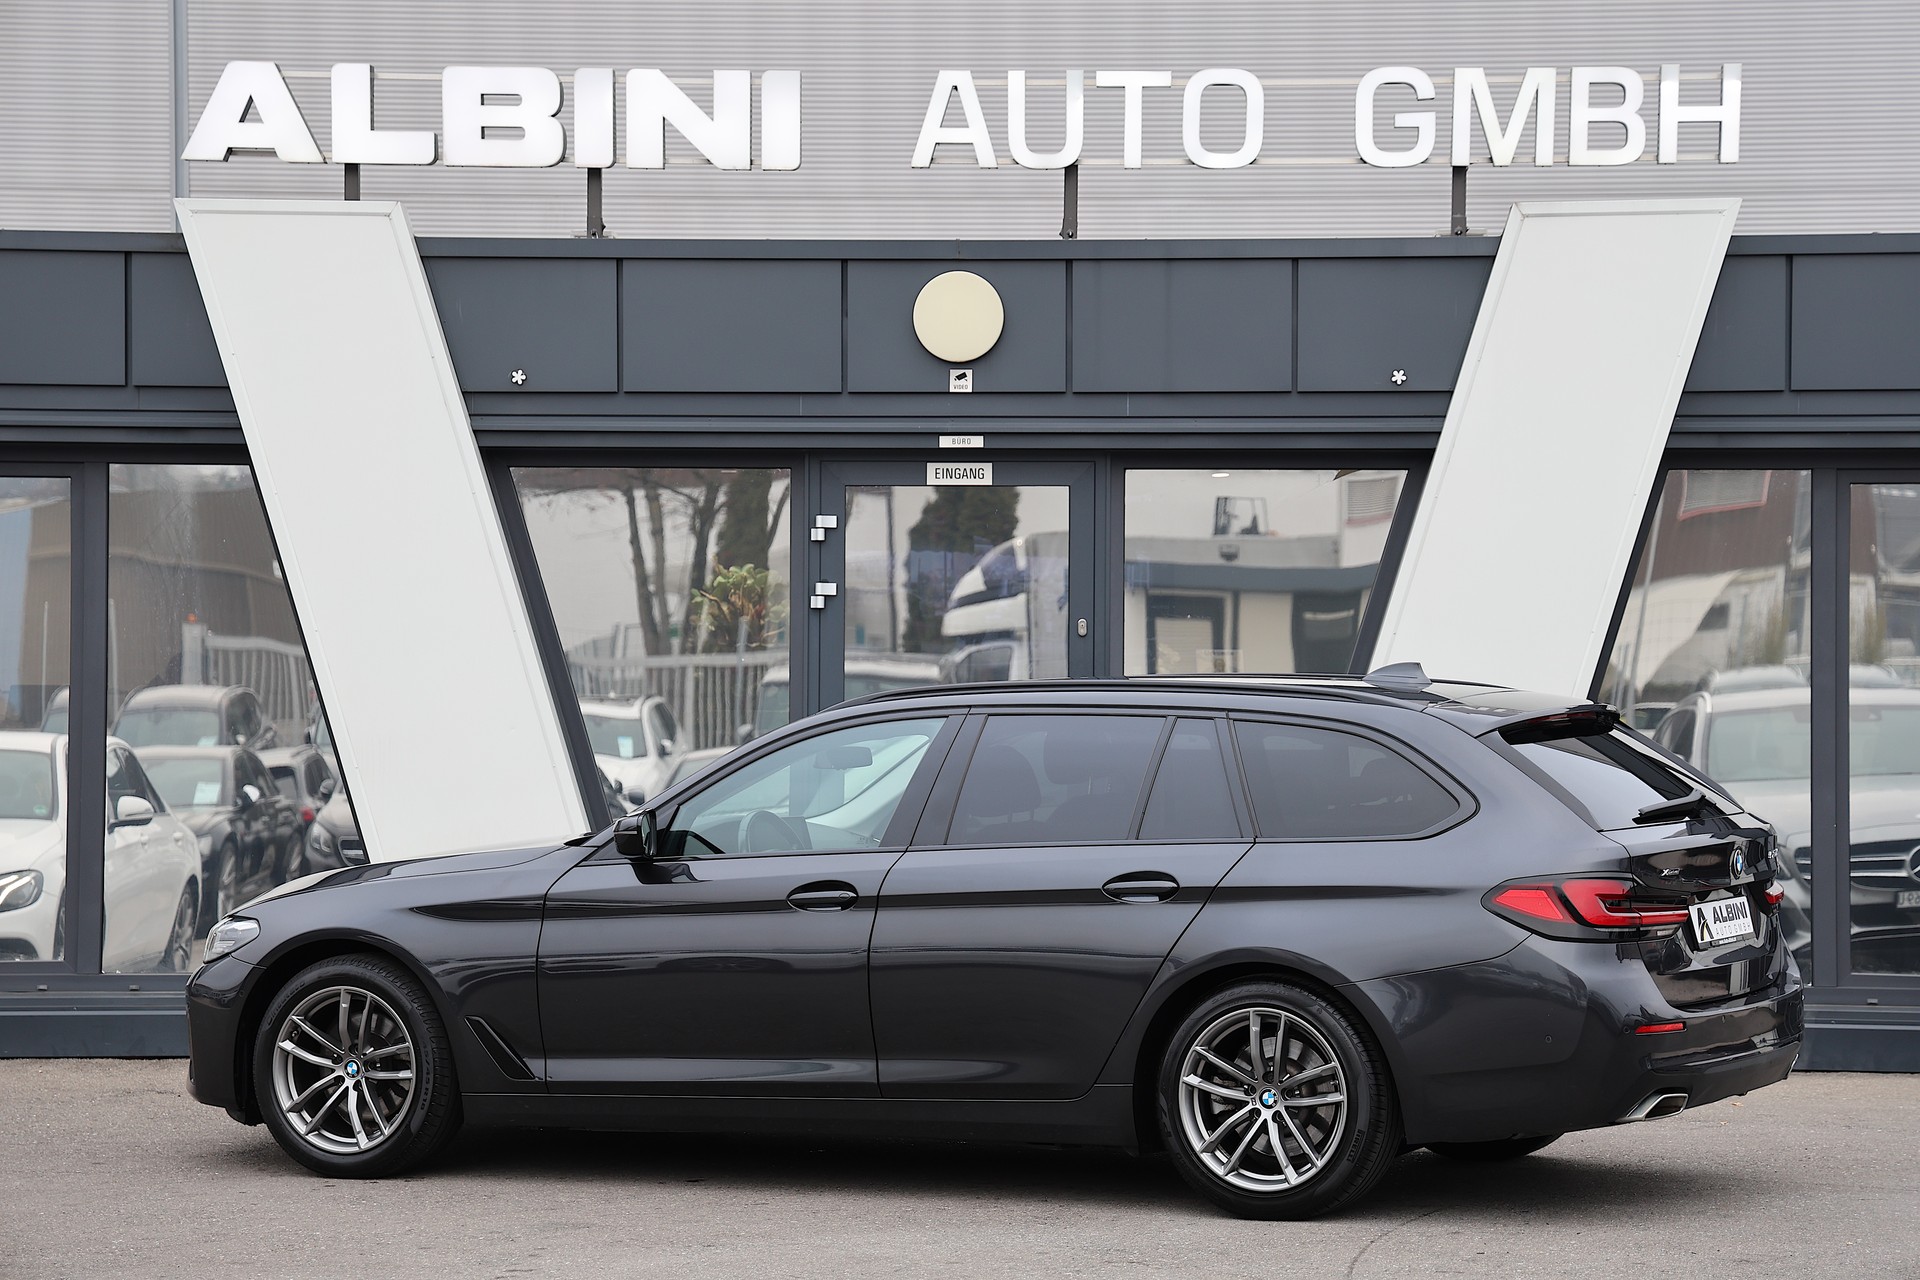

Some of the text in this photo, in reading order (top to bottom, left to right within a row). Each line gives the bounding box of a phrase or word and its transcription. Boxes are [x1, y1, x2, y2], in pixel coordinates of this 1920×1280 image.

[181, 60, 1742, 171] ALBINI AUTO GMBH
[935, 468, 985, 479] EINGANG
[1713, 902, 1748, 924] ALBINI
